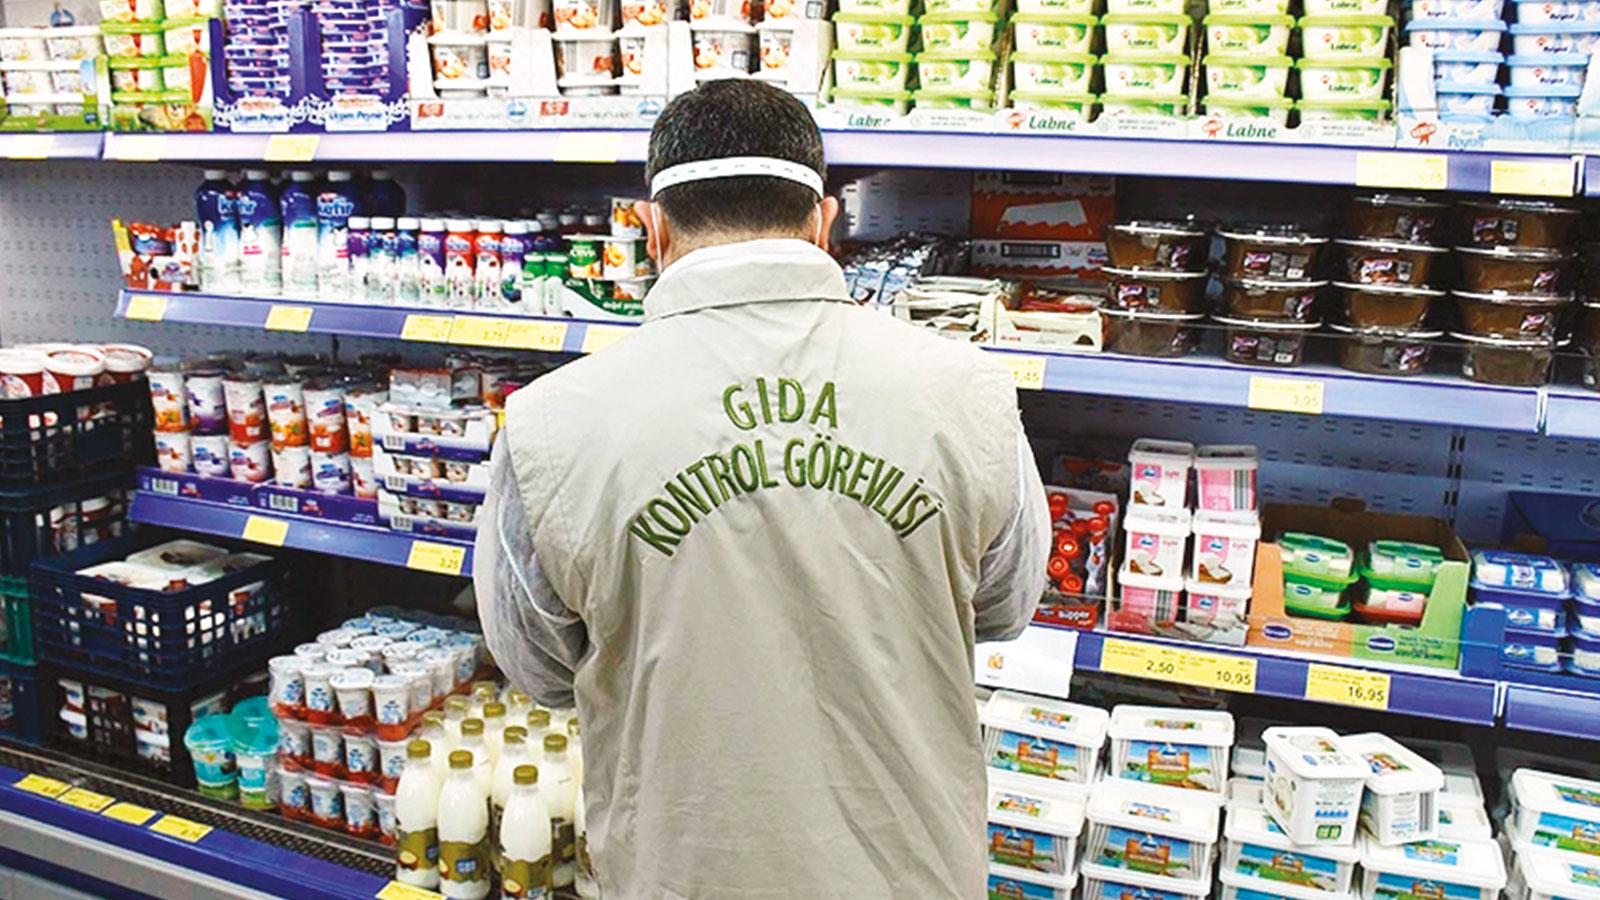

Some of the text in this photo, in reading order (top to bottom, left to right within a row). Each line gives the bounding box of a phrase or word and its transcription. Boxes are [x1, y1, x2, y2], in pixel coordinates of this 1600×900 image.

[1028, 115, 1077, 131] Labne
[1226, 122, 1278, 139] Labne
[722, 376, 838, 431] GIDA
[628, 432, 944, 557] KONTROL GÖREVLİSİ
